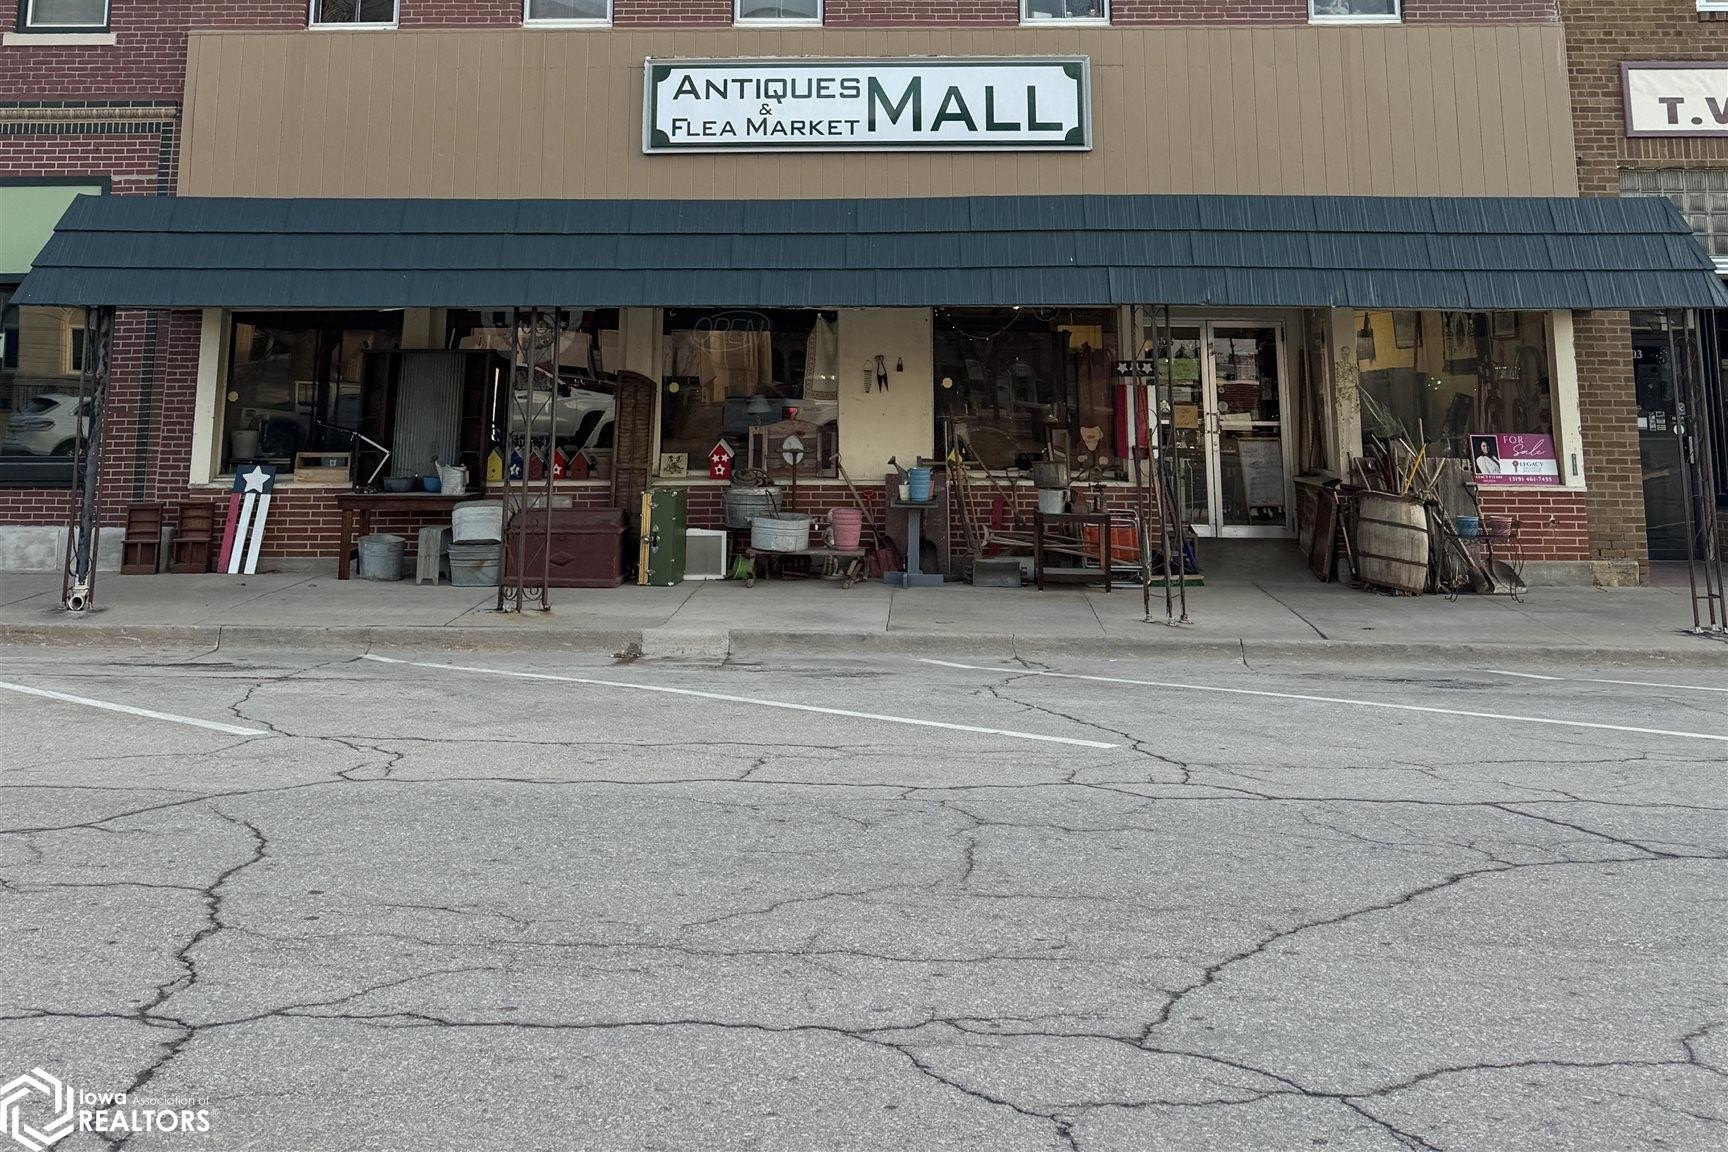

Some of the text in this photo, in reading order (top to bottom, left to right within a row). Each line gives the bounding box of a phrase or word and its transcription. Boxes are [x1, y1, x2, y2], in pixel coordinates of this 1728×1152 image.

[758, 103, 773, 116] &
[867, 76, 1063, 132] MALL
[693, 316, 764, 345] OPEN
[1503, 436, 1524, 444] FOR
[1513, 439, 1545, 456] Sale
